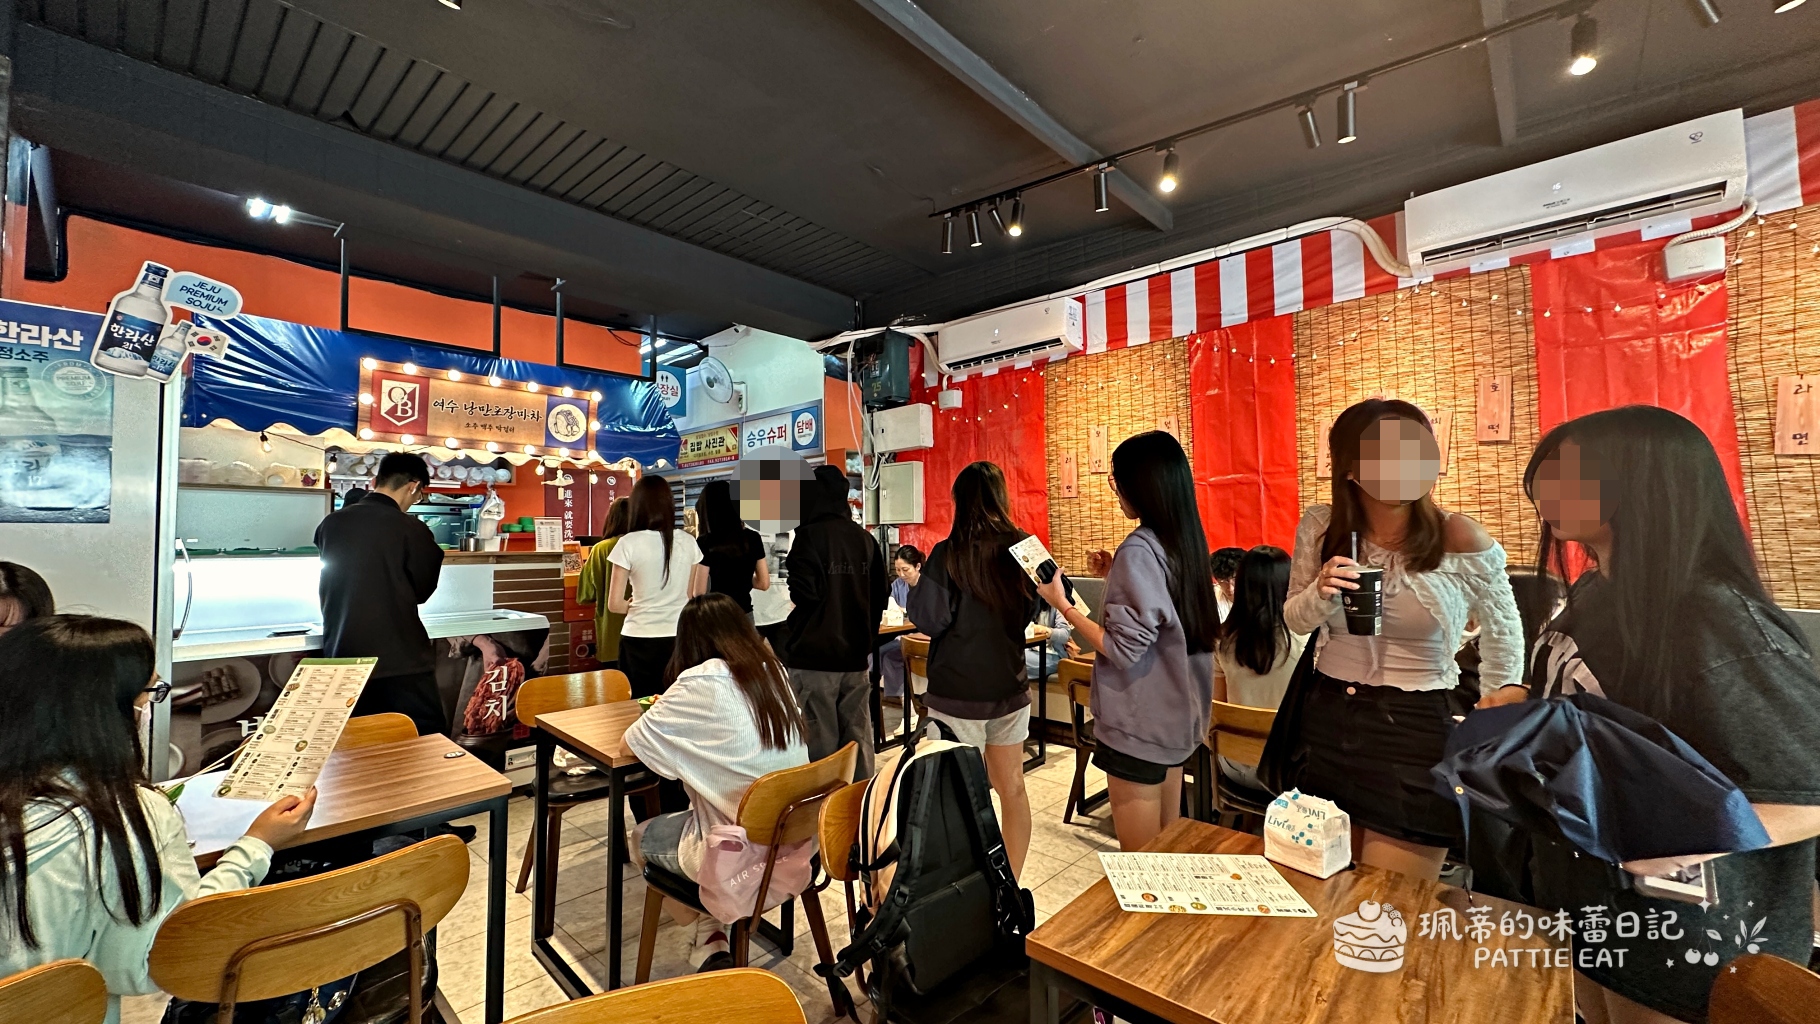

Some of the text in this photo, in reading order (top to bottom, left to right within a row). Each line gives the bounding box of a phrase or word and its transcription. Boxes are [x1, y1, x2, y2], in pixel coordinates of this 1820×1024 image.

[179, 285, 228, 306] PREMIUM
[193, 281, 221, 294] JEJU
[185, 297, 216, 312] SOJU
[0, 321, 84, 351] 한라산
[110, 322, 155, 347] 한라산
[121, 341, 133, 350] 21
[657, 383, 679, 397] 장실
[433, 398, 459, 413] 여수
[796, 418, 813, 434] 담배
[704, 436, 725, 450] 사진관
[747, 424, 787, 448] 승우슈퍼
[483, 666, 508, 721] 김치
[730, 870, 750, 887] AIR
